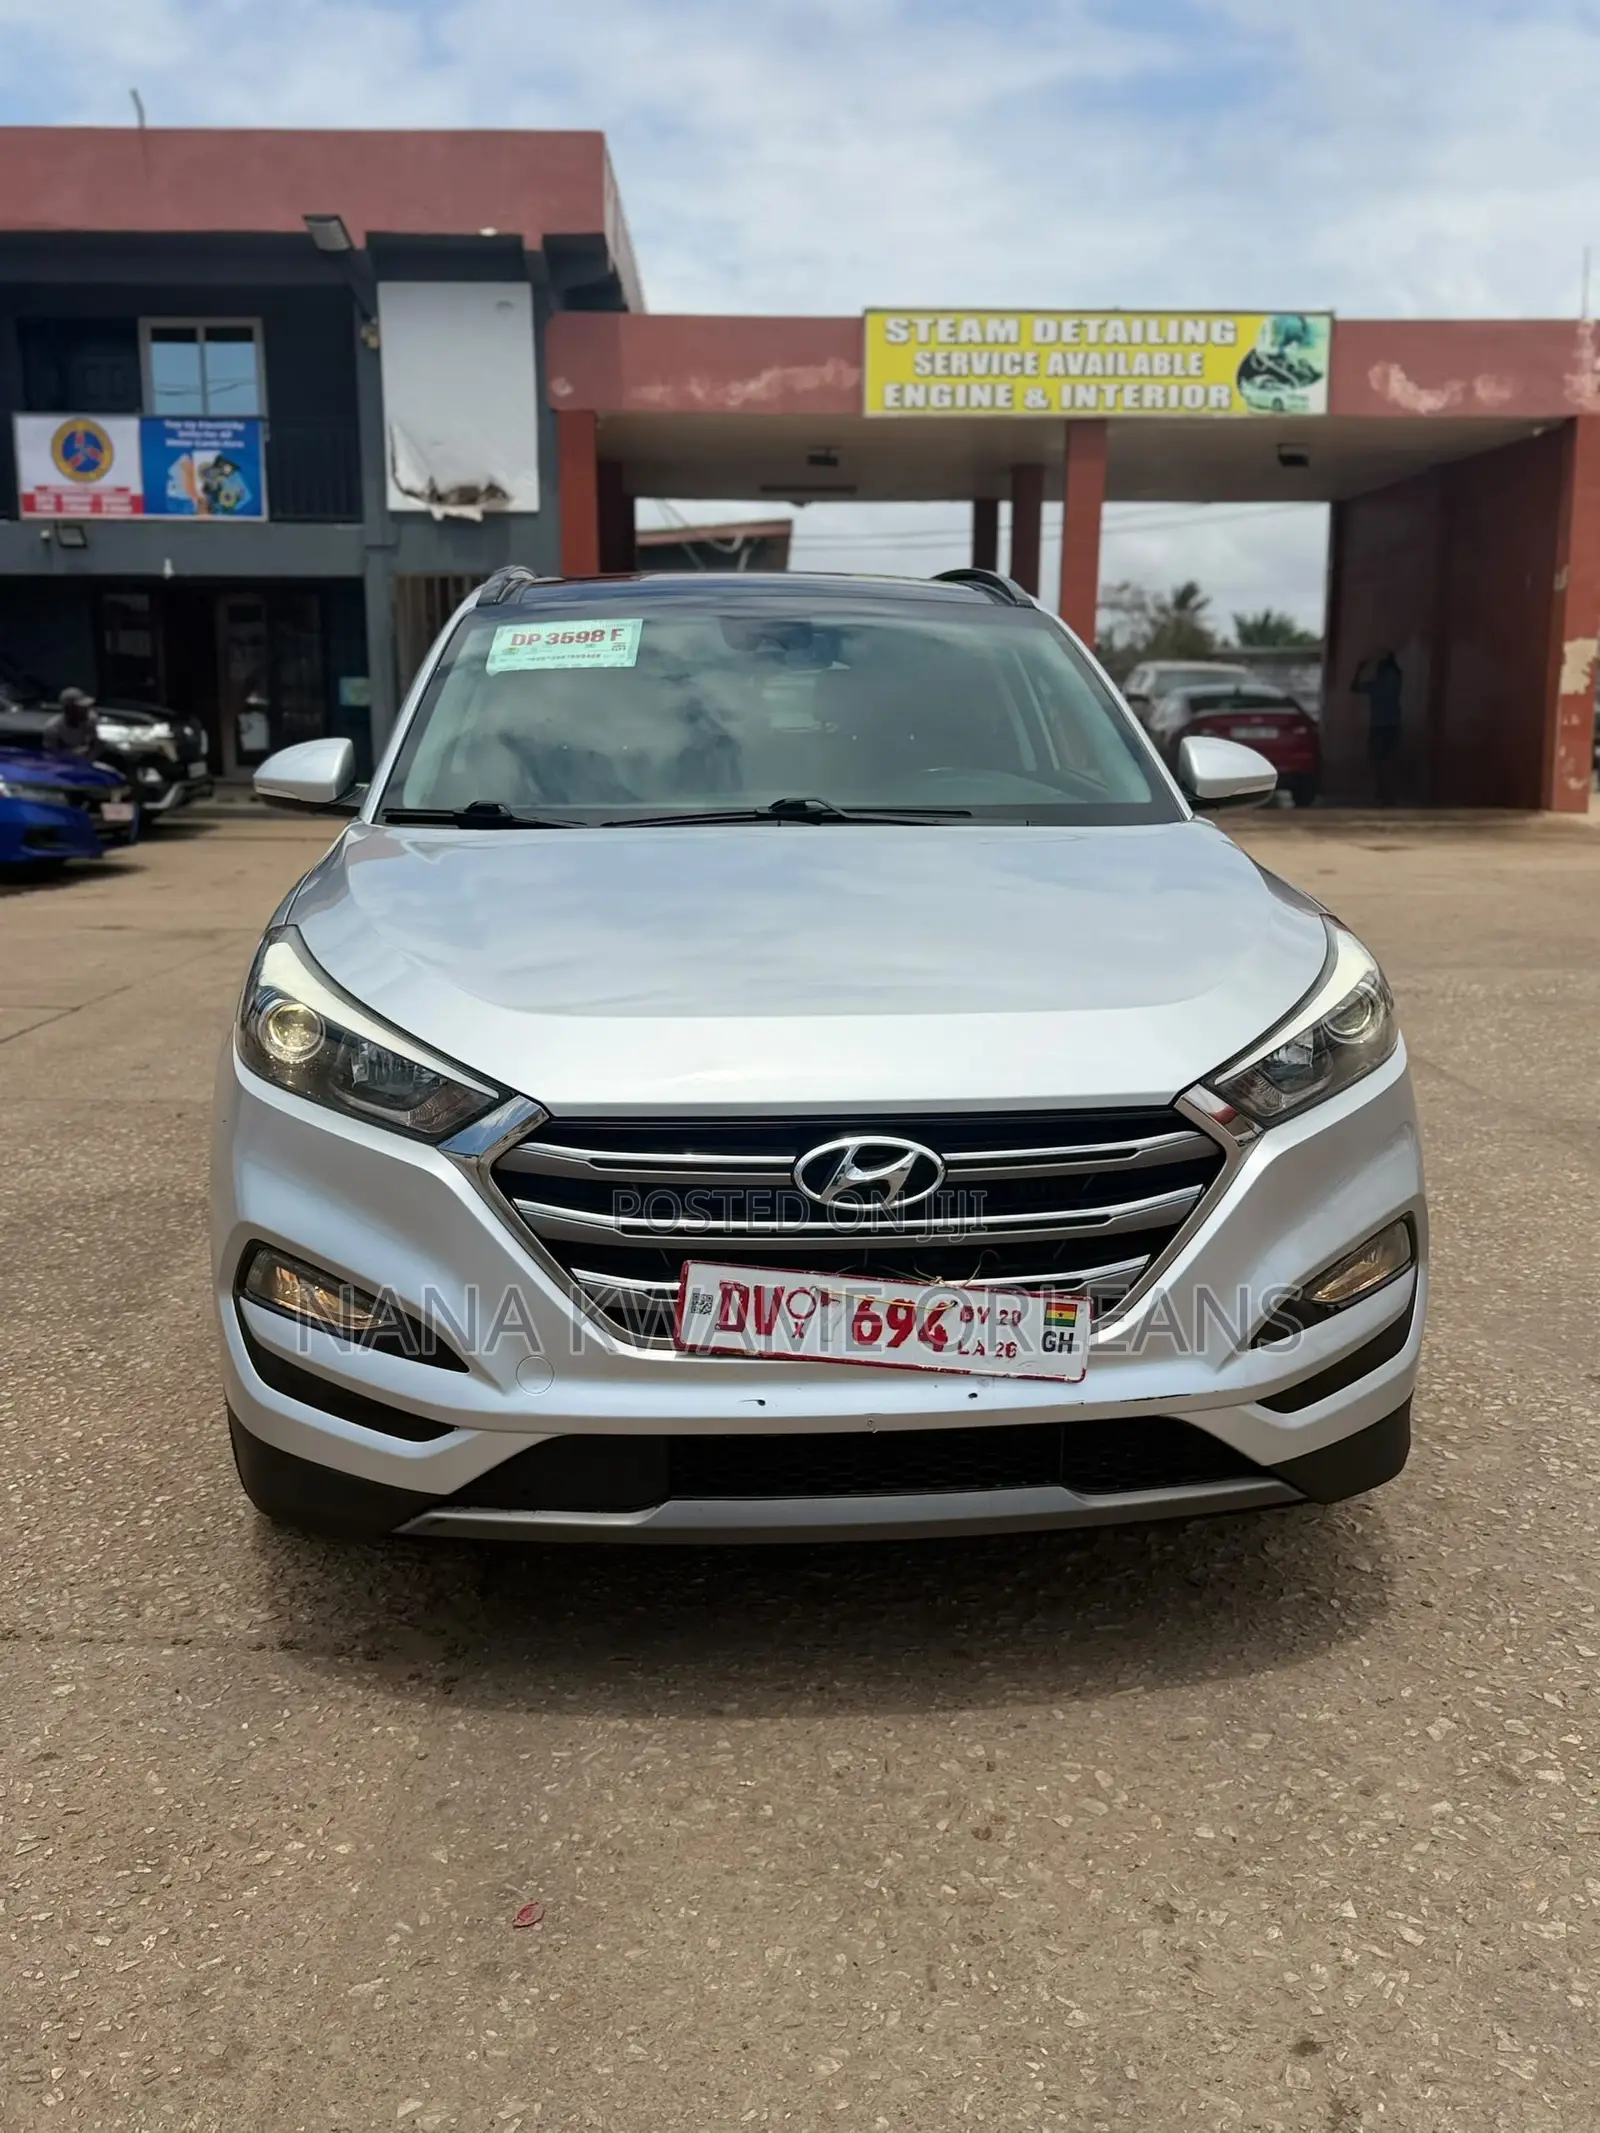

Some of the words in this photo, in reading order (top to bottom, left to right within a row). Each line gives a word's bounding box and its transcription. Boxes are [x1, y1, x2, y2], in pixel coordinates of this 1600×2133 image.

[885, 316, 1019, 344] STEAM
[1033, 317, 1237, 345] DETAILING
[913, 351, 1040, 377] SERVICE
[1046, 351, 1204, 377] AVAILABLE
[883, 382, 1014, 409] ENGINE
[1024, 386, 1050, 409] &
[1060, 382, 1232, 410] INTERIOR
[511, 632, 541, 647] DP
[610, 628, 625, 642] F
[1041, 1331, 1074, 1354] GH
